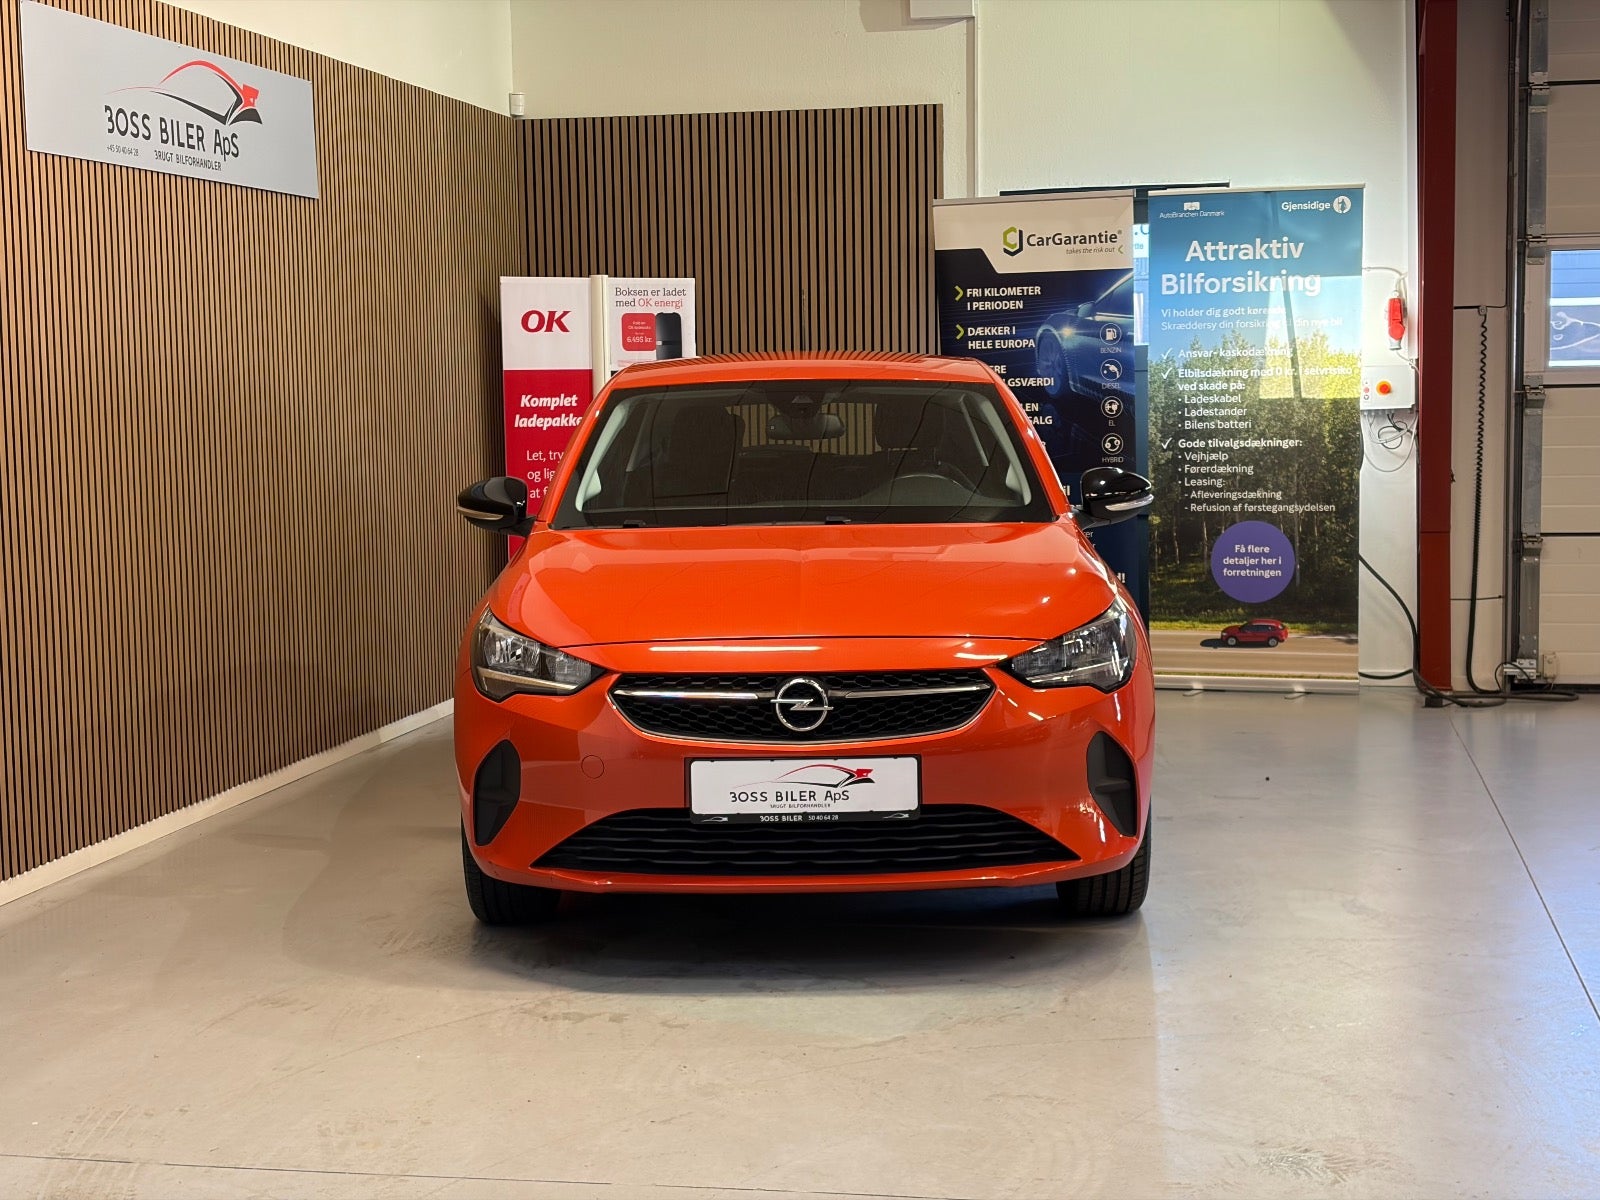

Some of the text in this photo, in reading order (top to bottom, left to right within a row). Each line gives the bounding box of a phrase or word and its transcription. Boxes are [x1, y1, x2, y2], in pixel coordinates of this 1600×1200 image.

[160, 117, 205, 152] BILER
[214, 129, 239, 161] ApS
[176, 154, 222, 171] BILFORHANDLER
[1281, 201, 1331, 213] Gjensidige
[1159, 211, 1199, 219] AutoBranchen
[1185, 236, 1304, 262] Attraktiv
[1161, 269, 1321, 297] Bilforsikring
[615, 287, 686, 297] Boksen er ladet
[966, 286, 1041, 298] FRI KILOMETER
[615, 298, 683, 309] med OK energi
[967, 300, 1024, 311] I PERIODEN
[1161, 309, 1171, 318] Vi
[1172, 307, 1204, 317] holder
[1206, 307, 1221, 318] dig
[1223, 307, 1245, 317] godt
[521, 310, 571, 333] OK
[1161, 321, 1217, 331] Skræddersy
[1219, 320, 1234, 329] din
[967, 326, 1016, 337] DÆKKER I
[968, 339, 1036, 350] HELE EUROPA
[1178, 368, 1249, 379] Elbilsdækning
[1250, 368, 1274, 377] med
[1004, 377, 1054, 387] GSVÆRDI
[1177, 380, 1246, 391] ved skade på:
[520, 393, 578, 410] Komplet
[1184, 394, 1242, 404] Ladeskabel
[1184, 407, 1248, 417] Ladestander
[1184, 420, 1252, 430] Bilens batteri
[1178, 438, 1303, 450] Gode tilvalgsdækninger:
[526, 450, 546, 462] Let,
[1184, 452, 1229, 462] Vejhjælp
[1184, 464, 1254, 475] Førerdækning
[527, 471, 541, 483] og
[1184, 477, 1226, 487] Leasing:
[529, 488, 540, 499] at
[1190, 490, 1282, 501] Afleveringsdækning
[1190, 503, 1336, 514] Refusion af førstegangsydelsen
[1234, 543, 1270, 553] Få flere
[1223, 556, 1282, 566] detaljer her i
[1223, 568, 1282, 578] forretningen
[775, 790, 816, 802] BILER
[824, 790, 850, 803] ApS
